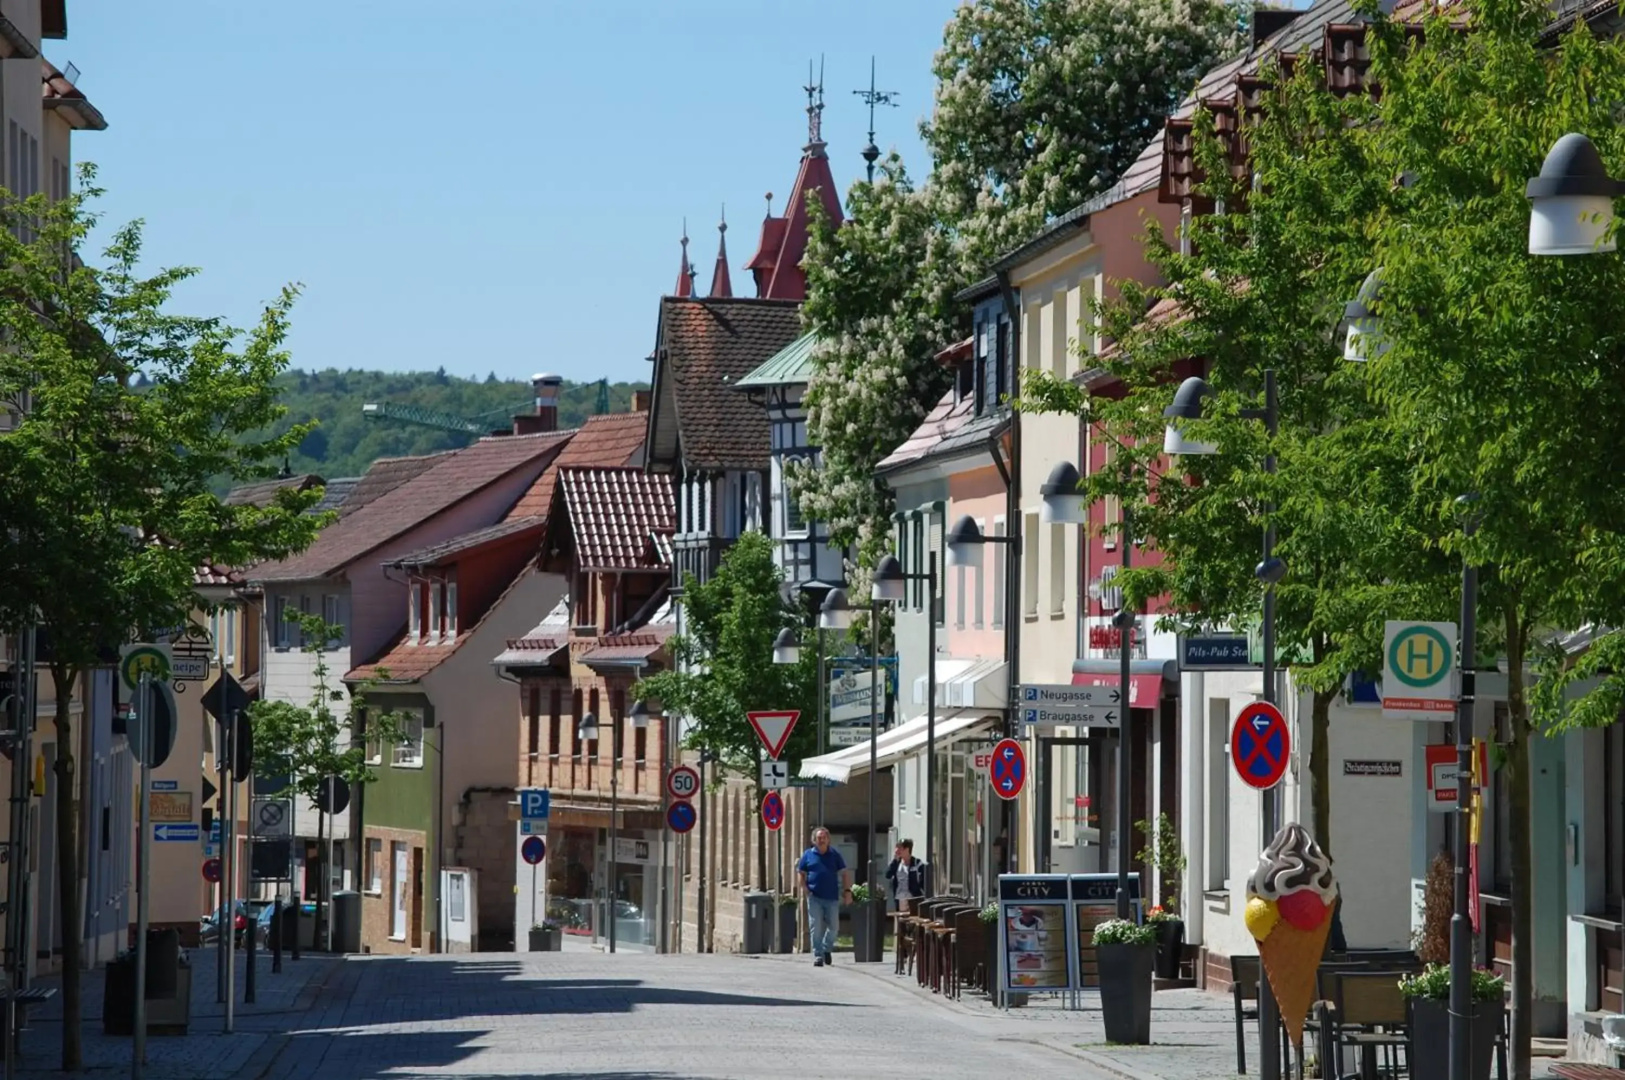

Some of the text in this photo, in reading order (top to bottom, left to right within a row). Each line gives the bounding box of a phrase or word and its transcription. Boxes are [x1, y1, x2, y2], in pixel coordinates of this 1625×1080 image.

[1188, 646, 1229, 658] Pils-Pub
[1407, 639, 1434, 674] H
[1040, 690, 1092, 702] Neugasse
[1039, 711, 1095, 723] Braugasse
[674, 775, 693, 791] 50
[527, 794, 542, 815] P
[1017, 886, 1051, 896] CITY
